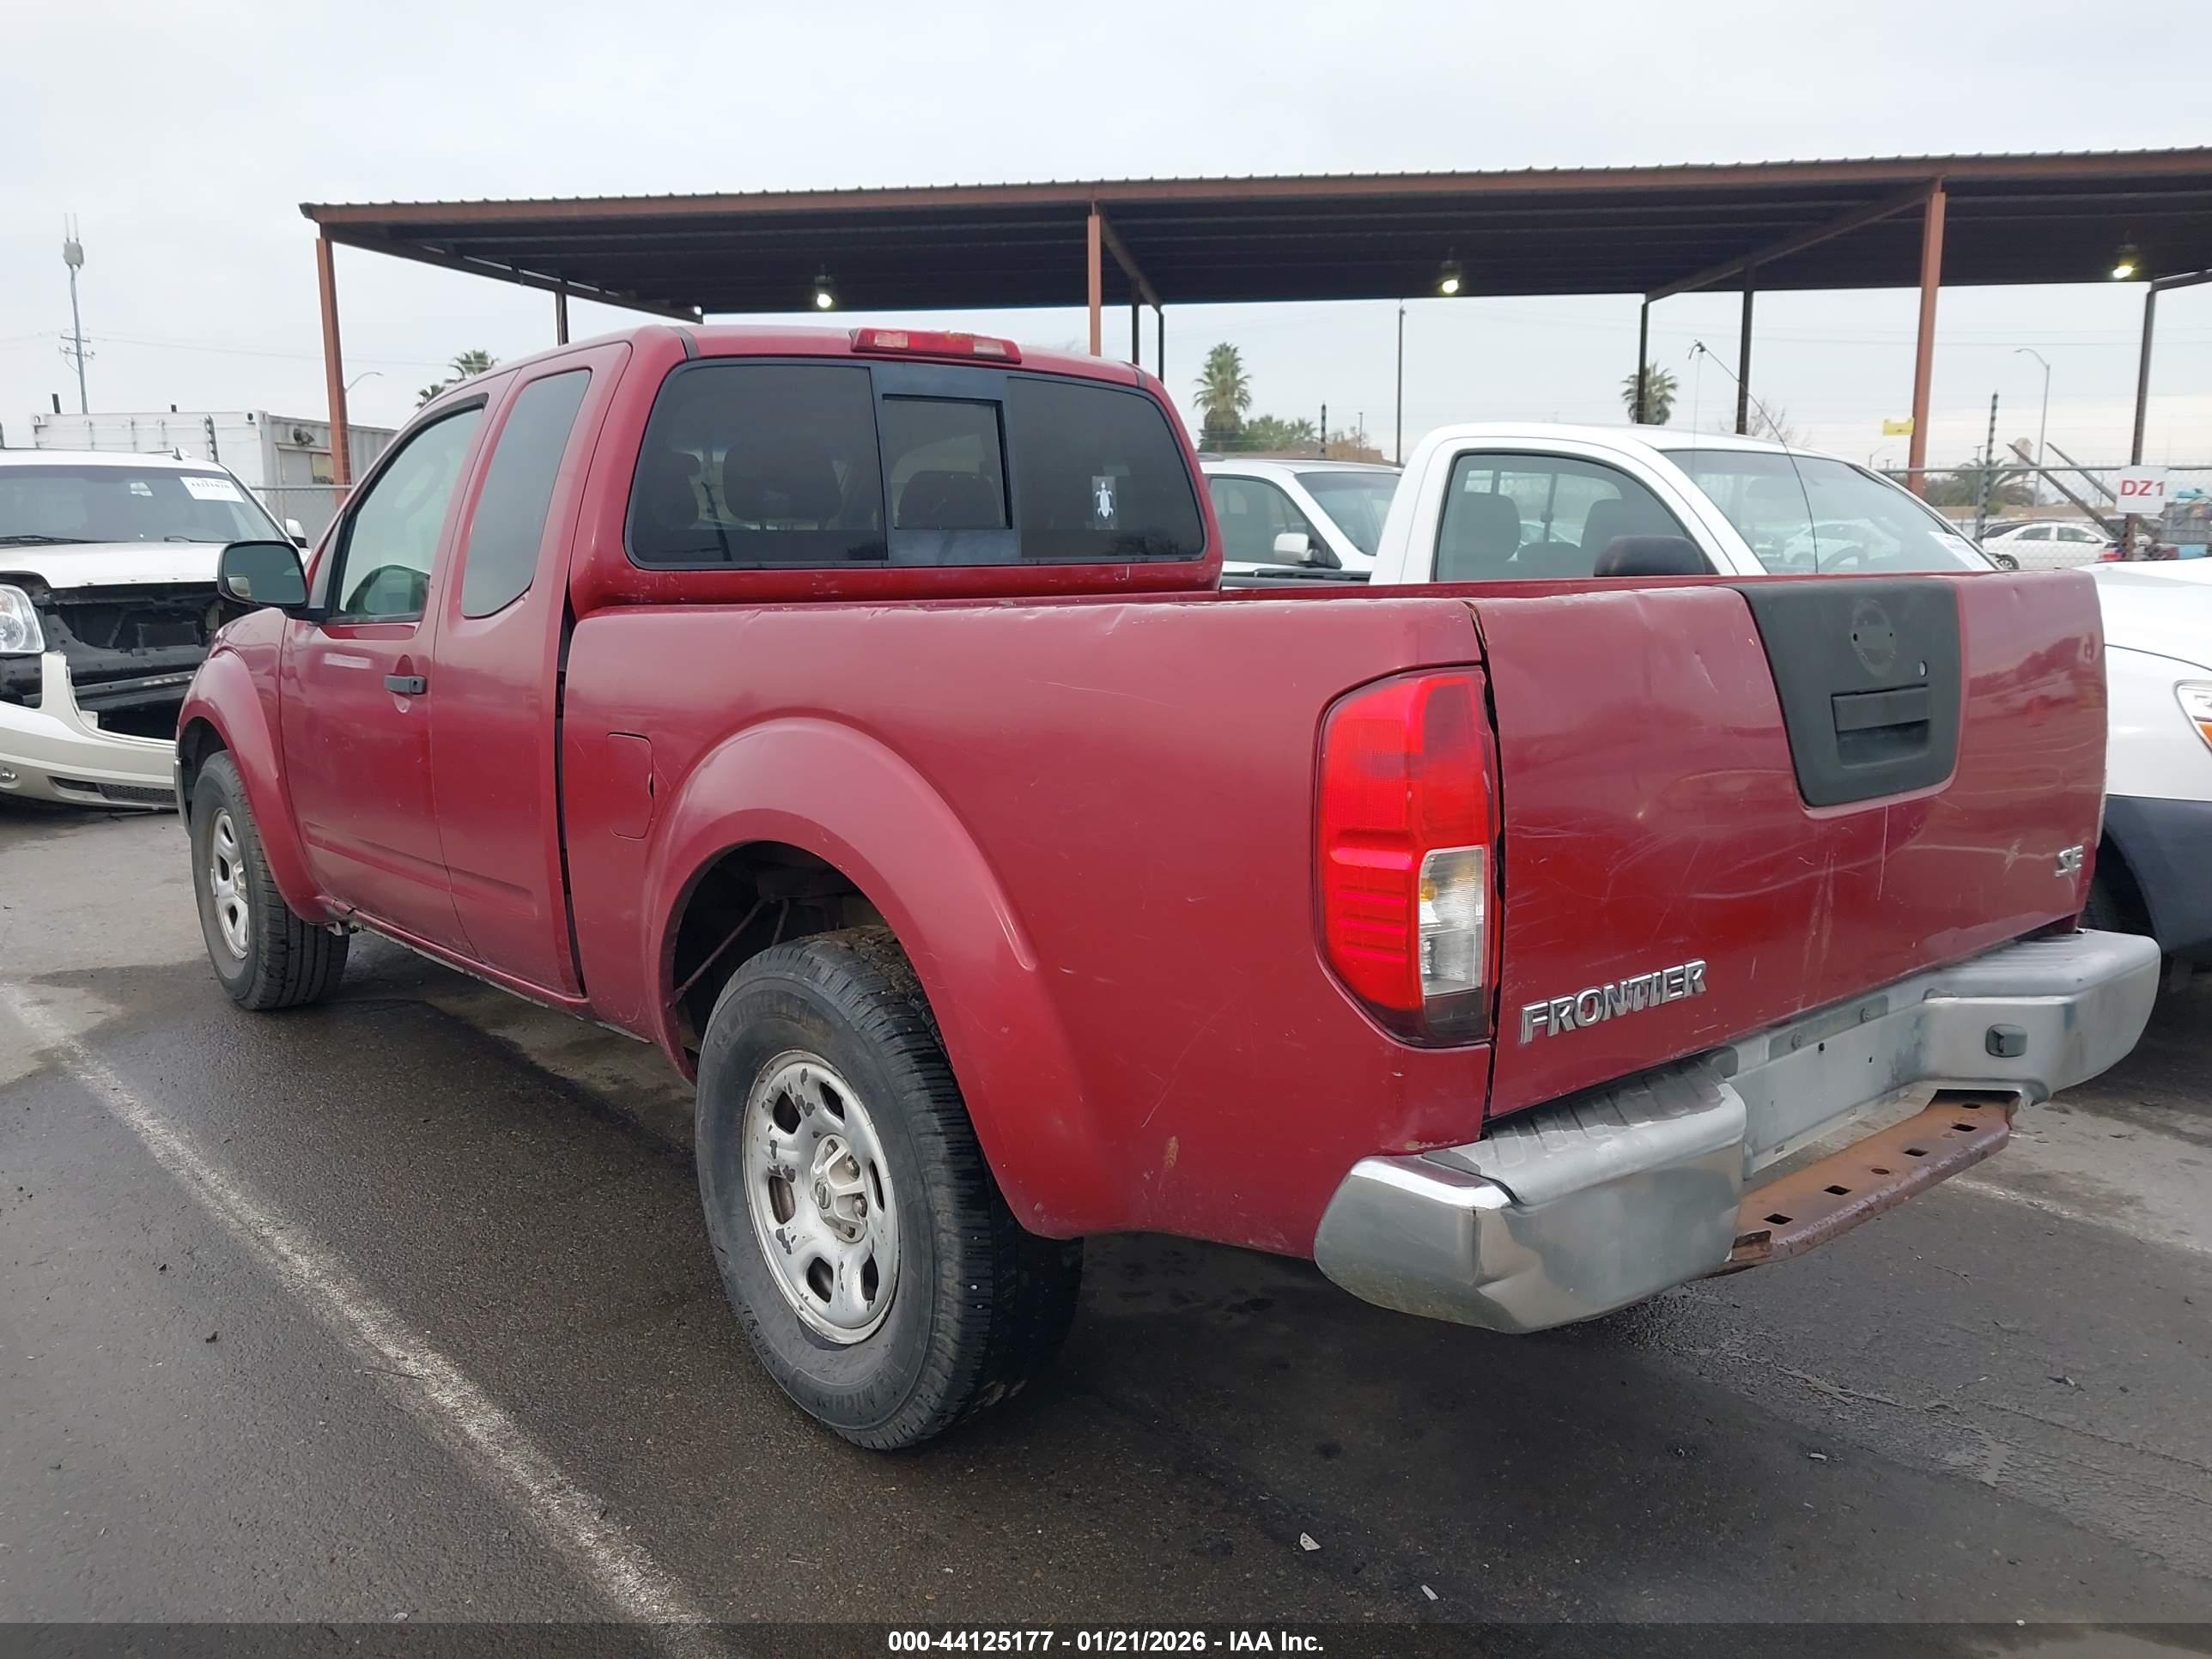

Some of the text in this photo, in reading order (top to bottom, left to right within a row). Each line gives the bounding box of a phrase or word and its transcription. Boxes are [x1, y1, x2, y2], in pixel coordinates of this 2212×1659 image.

[2121, 480, 2165, 496] DZ1
[2055, 845, 2083, 878] SE
[1519, 958, 1707, 1045] FRONTIER
